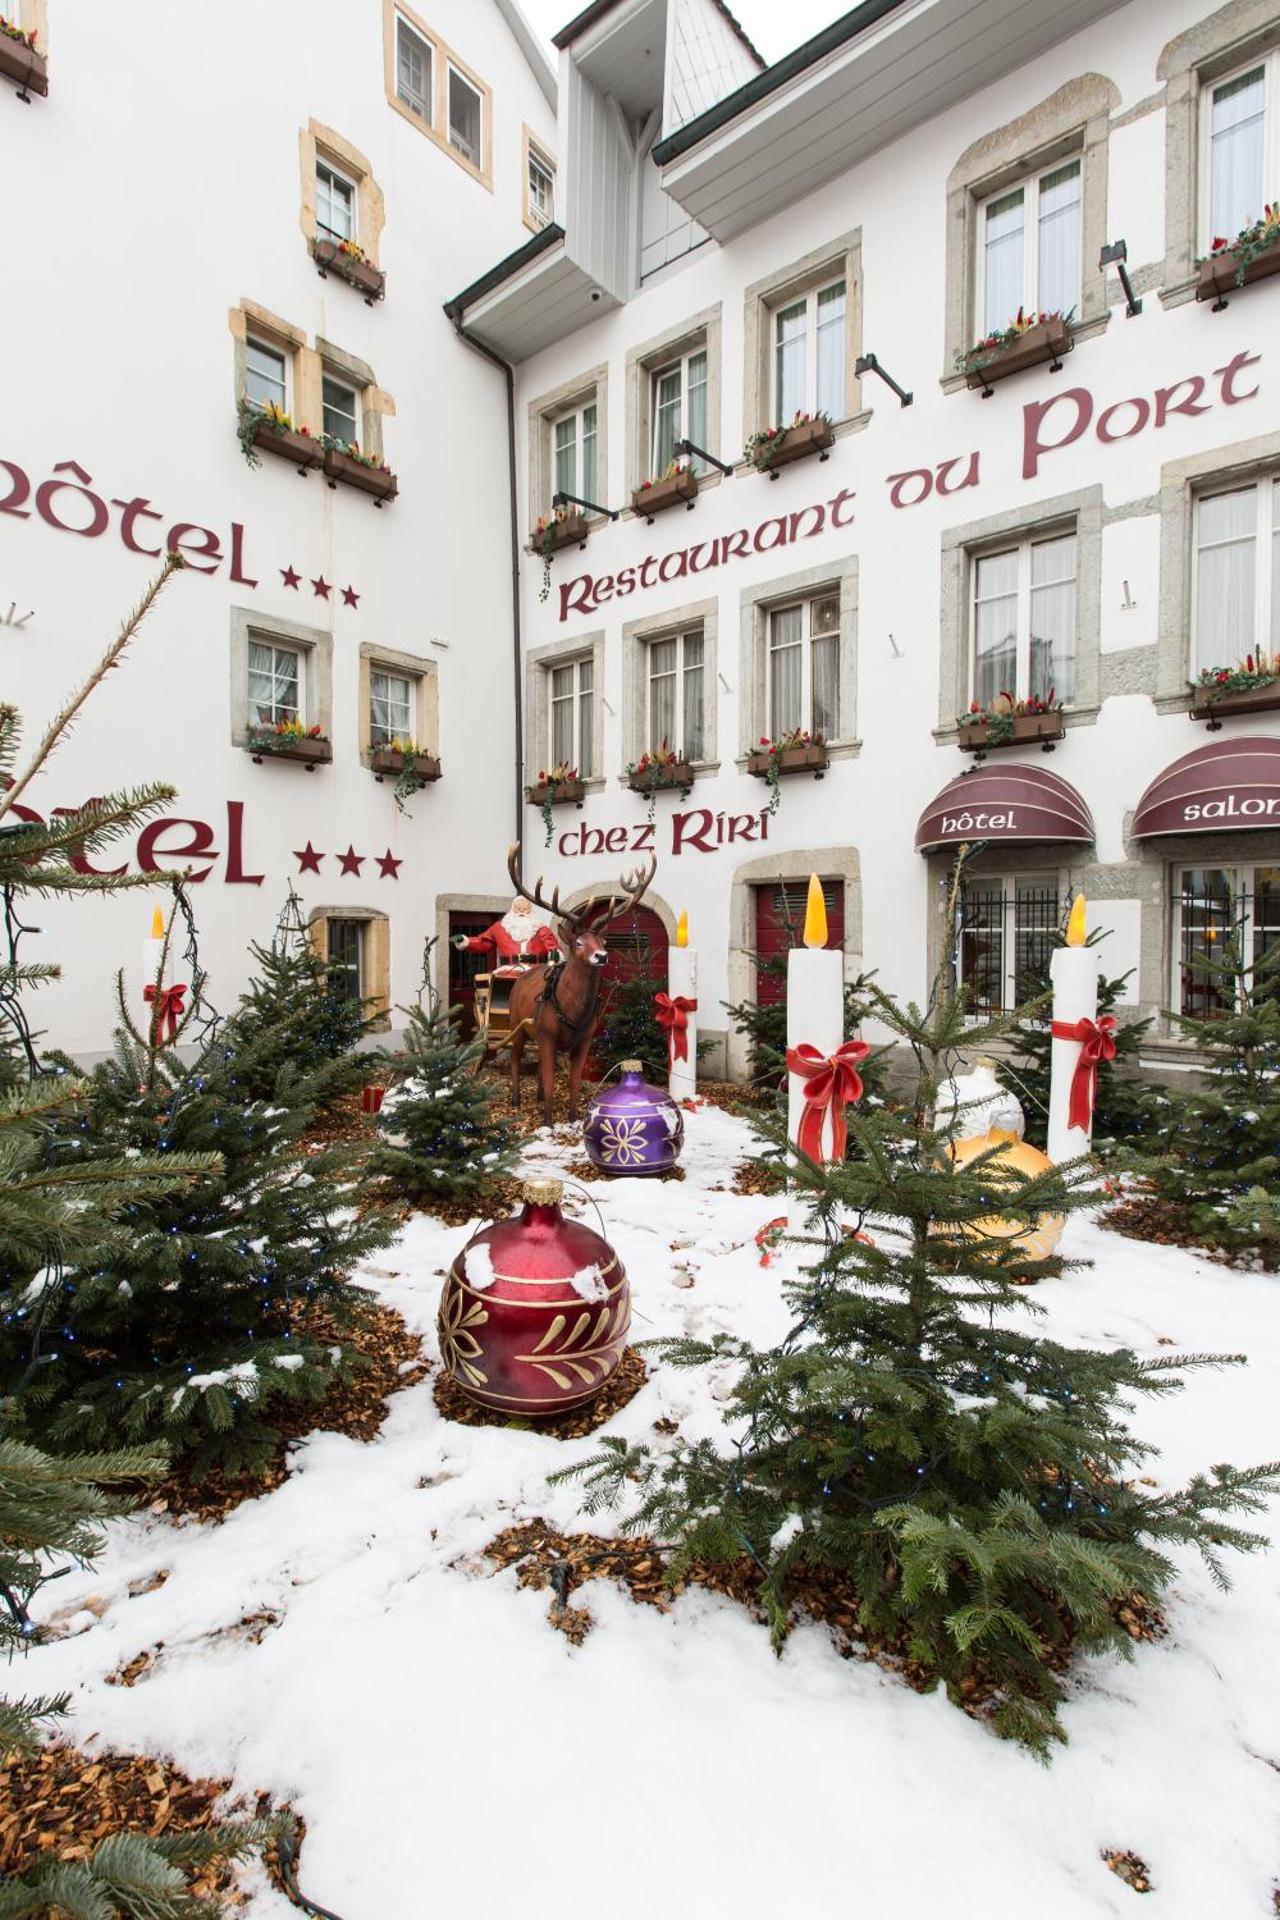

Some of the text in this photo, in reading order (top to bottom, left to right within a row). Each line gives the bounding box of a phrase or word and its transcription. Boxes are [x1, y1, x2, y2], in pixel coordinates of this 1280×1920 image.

[559, 489, 856, 622] Restaurant
[1022, 350, 1262, 480] Port
[558, 821, 655, 857] chez
[941, 811, 1017, 834] hôtel
